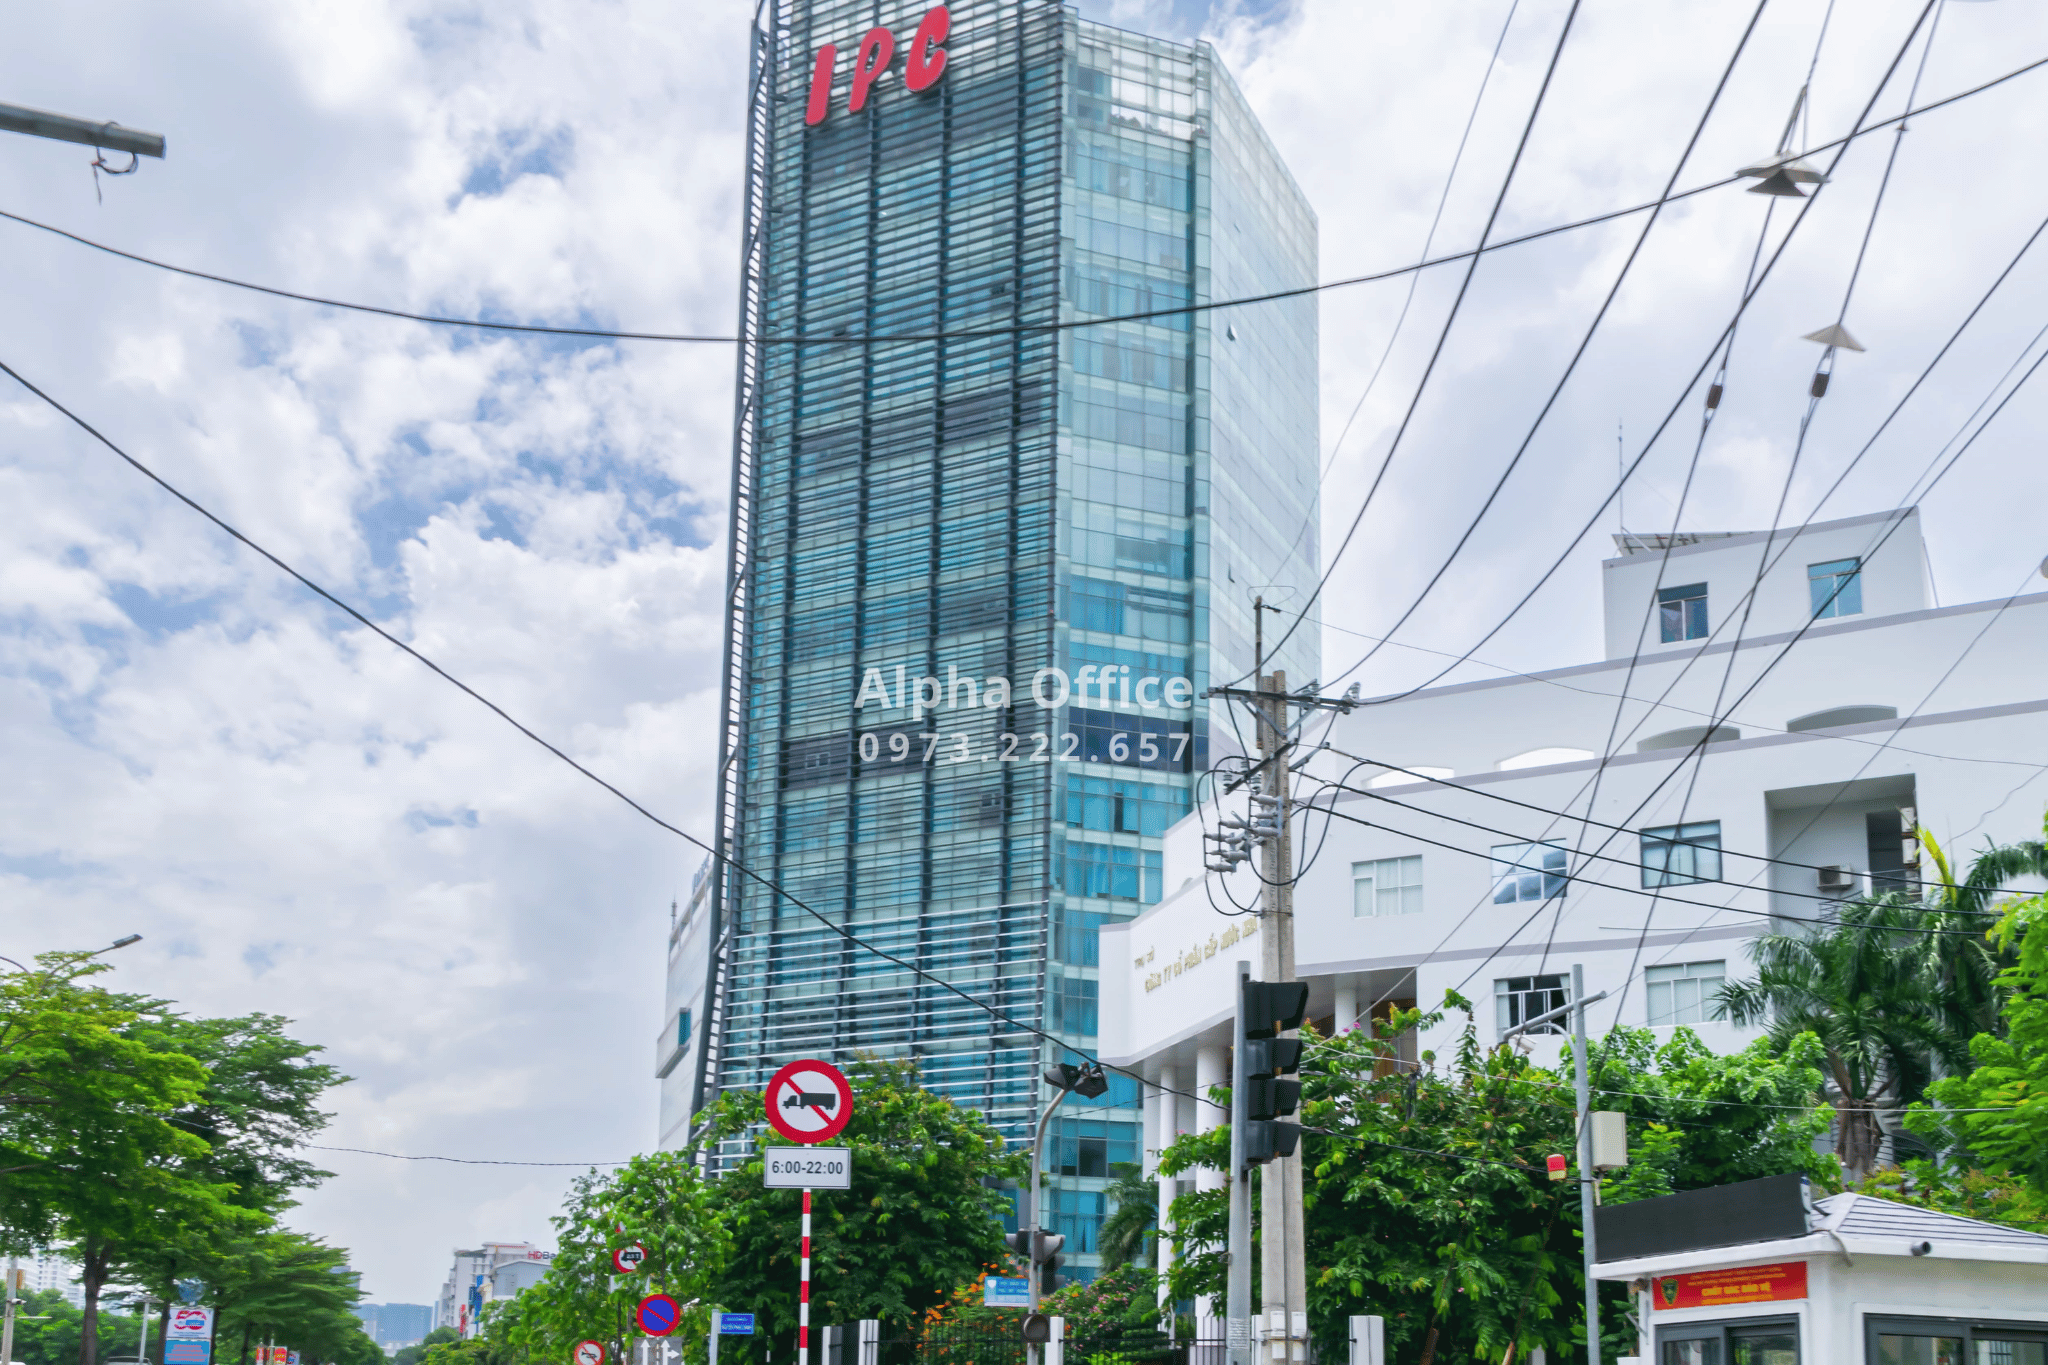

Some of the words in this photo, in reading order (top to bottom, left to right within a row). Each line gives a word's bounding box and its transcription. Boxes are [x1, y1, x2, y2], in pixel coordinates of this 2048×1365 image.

[805, 5, 951, 126] IPC
[771, 1160, 844, 1175] 6:00-22:00
[527, 1250, 558, 1260] HDBa
